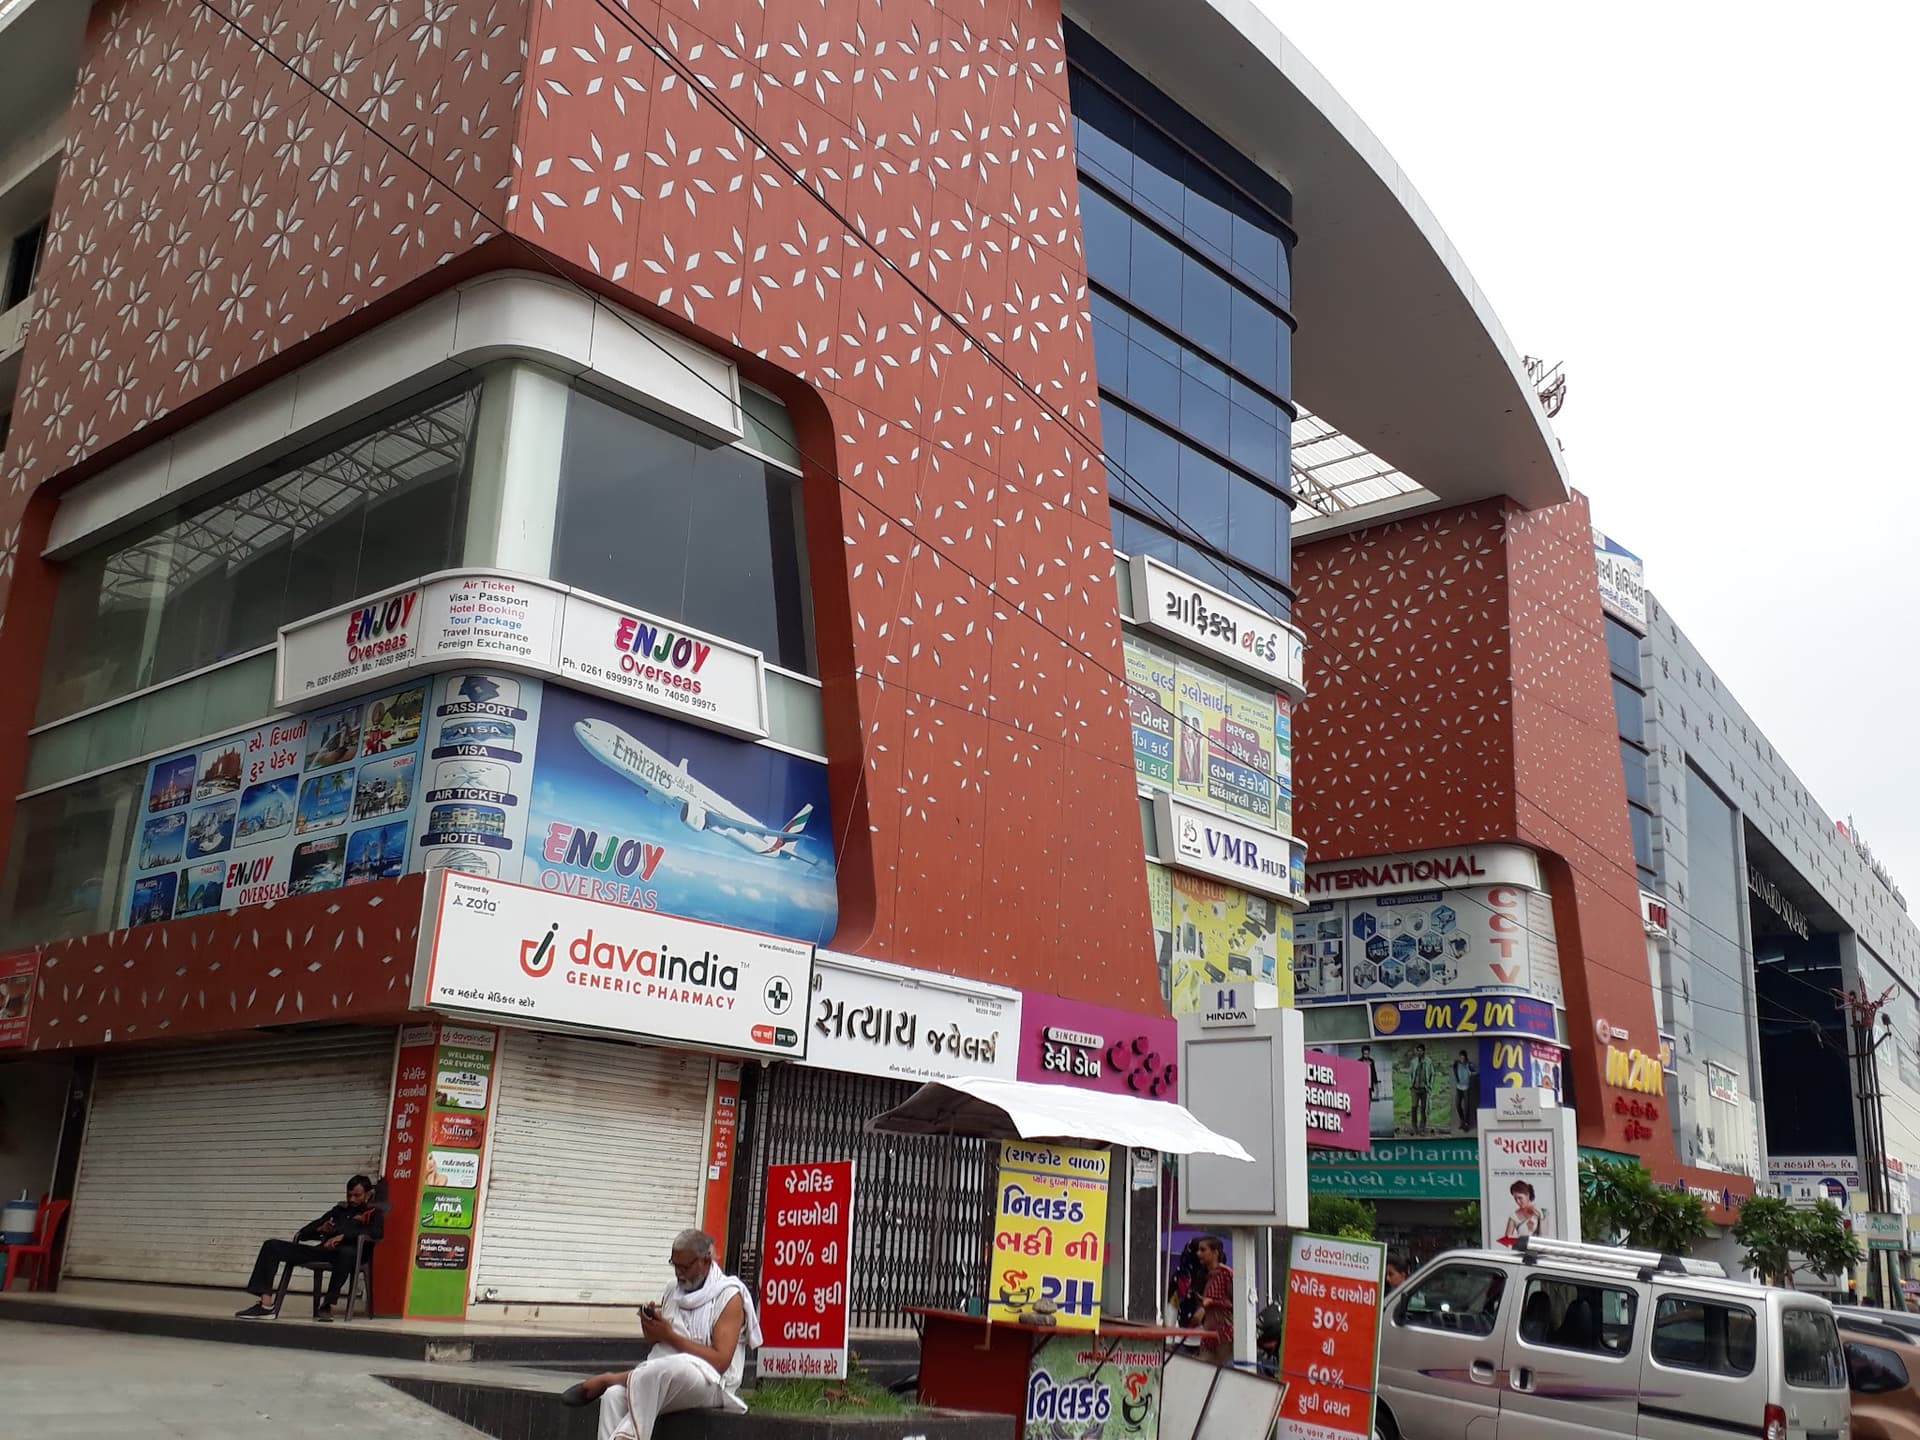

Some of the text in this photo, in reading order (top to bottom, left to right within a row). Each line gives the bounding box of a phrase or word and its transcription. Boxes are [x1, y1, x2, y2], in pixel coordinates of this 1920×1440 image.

[463, 580, 516, 593] Air Ticket
[449, 592, 469, 604] Visa
[478, 592, 528, 608] Passport
[449, 603, 525, 619] Hotel Booking
[346, 592, 417, 646] ENJOY
[450, 615, 522, 630] Tour Package
[1165, 591, 1237, 645] ગ્રાફિક્સ
[442, 626, 529, 643] Travel Insurance
[614, 616, 711, 674] ENJOY
[348, 632, 408, 664] Overseas
[437, 638, 532, 656] Foreign Exchange
[562, 656, 578, 670] Ph.
[580, 662, 602, 677] 0261
[605, 667, 643, 690] 6999975
[664, 688, 690, 704] 74050
[691, 696, 717, 712] 99975
[620, 653, 702, 694] Overseas
[446, 702, 514, 717] PASSPORT
[270, 719, 308, 747] દિવાળી
[458, 726, 501, 735] VISA
[270, 748, 298, 770] પેકેજ
[457, 745, 489, 756] VISA
[612, 734, 673, 790] Emirates
[1151, 742, 1169, 758] કાર્ડ
[1150, 764, 1168, 780] કાર્ડ
[434, 788, 506, 803] AIR TICKET
[440, 833, 485, 845] HOTEL
[542, 821, 666, 882] ENJOY
[1205, 827, 1287, 879] VMR HUB
[226, 855, 274, 889] ENJOY
[1305, 855, 1485, 893] NTERNATIONAL
[238, 881, 286, 906] OVERSEAS
[454, 881, 489, 895] Powered By
[541, 869, 658, 912] OVERSEAS
[1172, 871, 1225, 899] VMR HUB
[466, 897, 497, 912] zota
[569, 928, 738, 991] davaindia
[457, 988, 485, 1001] મહાદેવ
[566, 969, 736, 1010] GENERIC PHARMACY
[815, 998, 999, 1064] સત્યાય જવેલર્સ
[1055, 1030, 1097, 1045] SINCE 1984
[447, 1050, 485, 1061] WELLNESS
[455, 1060, 491, 1070] EVERYONE
[1044, 1042, 1101, 1078] ડેરી ડોન
[1304, 1063, 1337, 1085] CHER.
[1304, 1109, 1344, 1133] ASTIER.
[1502, 1139, 1548, 1154] સત્યાય
[1005, 1145, 1106, 1175] (રાજકોટ વાળા)
[1518, 1155, 1548, 1168] જવેલર્સ
[785, 1168, 834, 1194] જેનેરિક
[1311, 1170, 1466, 1187] અપોલો ફાર્મસી
[432, 1203, 462, 1213] AMLA
[777, 1201, 839, 1227] દવાઓથી
[1002, 1184, 1085, 1224] નિલકંઠ
[1871, 1220, 1900, 1233] Apollo
[774, 1239, 838, 1267] 30% થી
[1064, 1231, 1098, 1262] ની
[1314, 1245, 1370, 1265] davaindia
[766, 1278, 842, 1313] 90% સુધી
[1290, 1275, 1376, 1307] જેનેરિક દવાઓથી
[783, 1321, 821, 1340] બચત
[1312, 1306, 1349, 1333] 30%
[1322, 1338, 1335, 1356] થી
[1298, 1393, 1351, 1417] સુધી બચત
